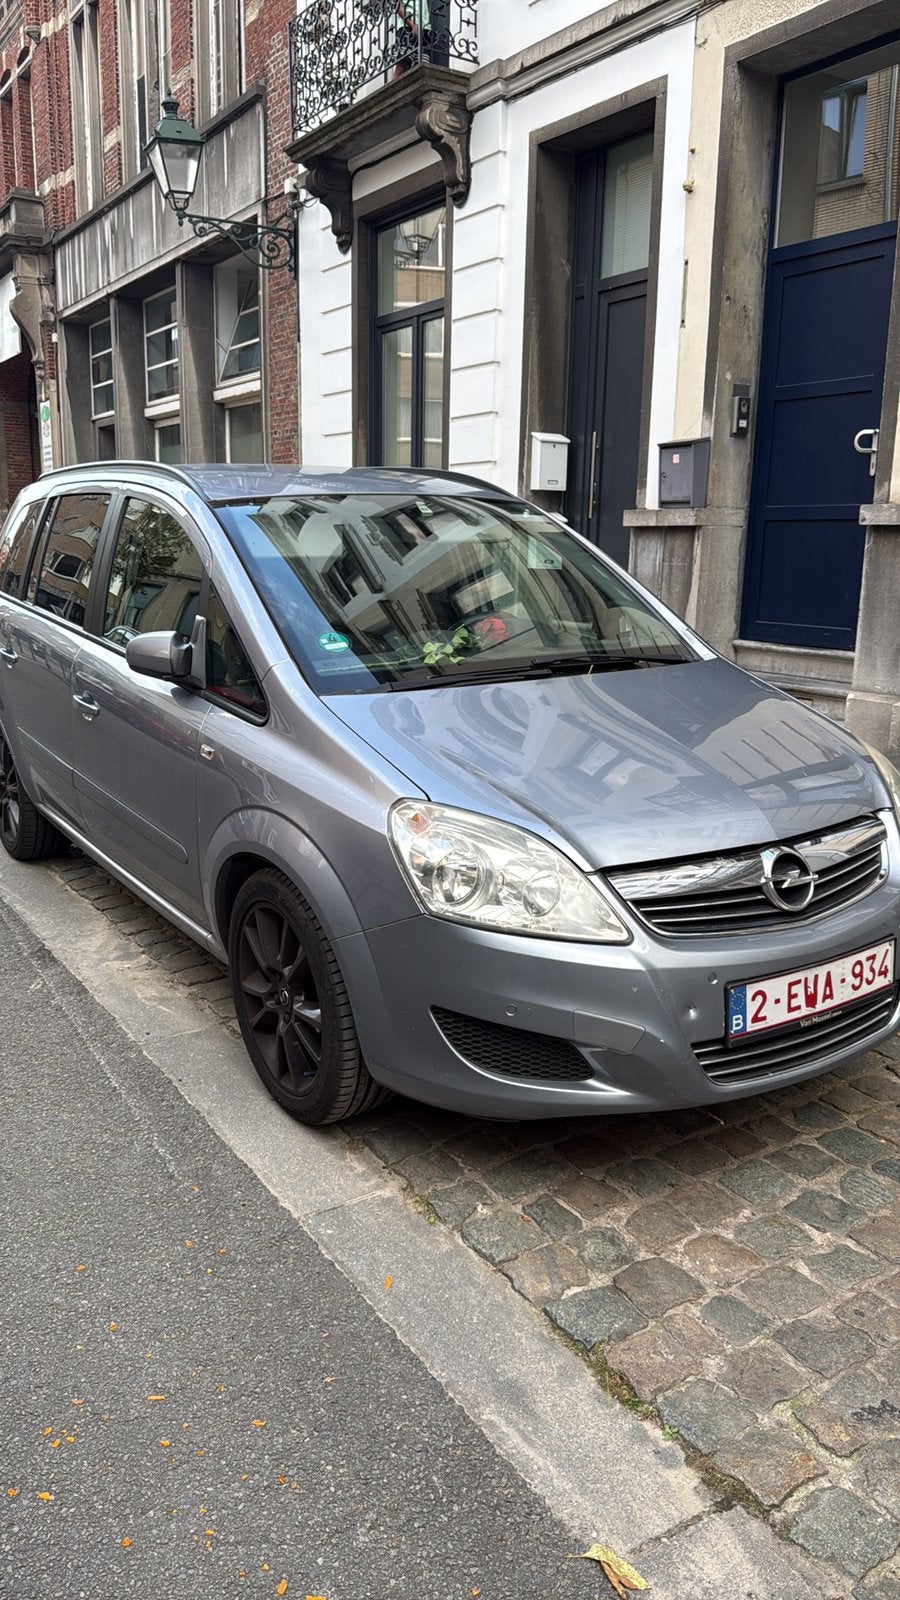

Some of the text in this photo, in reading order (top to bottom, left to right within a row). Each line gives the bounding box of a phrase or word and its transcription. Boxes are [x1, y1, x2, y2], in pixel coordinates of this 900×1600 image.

[328, 633, 338, 643] 4
[732, 1014, 744, 1031] B
[800, 1018, 812, 1028] Van
